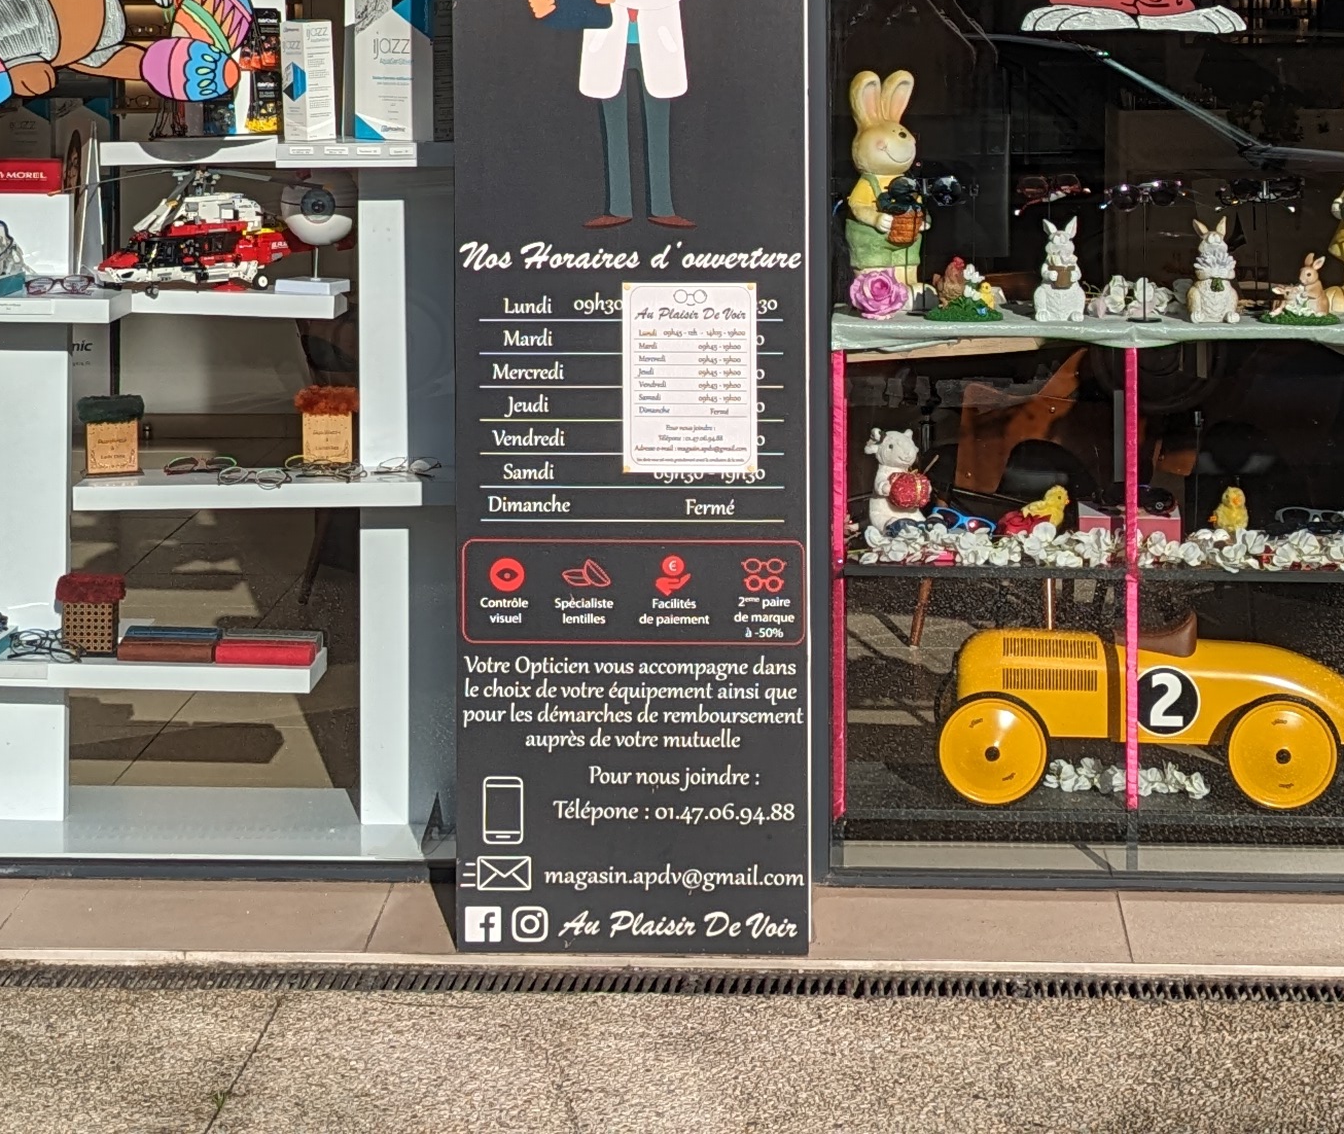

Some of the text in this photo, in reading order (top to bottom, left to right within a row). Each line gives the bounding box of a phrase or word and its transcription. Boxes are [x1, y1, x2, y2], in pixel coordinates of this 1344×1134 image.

[6, 171, 47, 179] MOREL
[459, 241, 802, 271] Nos Horaires d'ouverture
[503, 292, 623, 315] Lundi 09h30
[634, 307, 747, 321] Au Plaisir De Voir
[503, 329, 554, 347] Mardi
[492, 361, 565, 380] Mercredi
[504, 394, 550, 418] Jeudi
[492, 427, 565, 446] Vendredi
[503, 461, 555, 480] Samdi
[488, 495, 735, 516] Dimanche Fermé
[480, 597, 530, 609] Contrôle
[652, 597, 697, 610] Facilités
[761, 596, 792, 610] paire
[489, 612, 523, 624] visuel
[562, 613, 607, 625] lentilles
[639, 613, 711, 628] de paiement
[733, 612, 796, 627] de marque
[744, 626, 784, 639] à -50%
[463, 655, 797, 680] Votre Opticien vous accompagne dans
[464, 678, 798, 706] le choix de votre équipement ainsi que
[1150, 672, 1184, 727] 2
[463, 702, 804, 728] pour les démarches de remboursement
[525, 728, 741, 753] auprès de votre mutuelle
[589, 765, 749, 792] Pour nous joindre
[553, 799, 796, 826] Télépone 01.47.06.94.88
[544, 863, 805, 891] magasin.apdv@gmail.com
[558, 910, 799, 938] Au Plaisir De Voir
